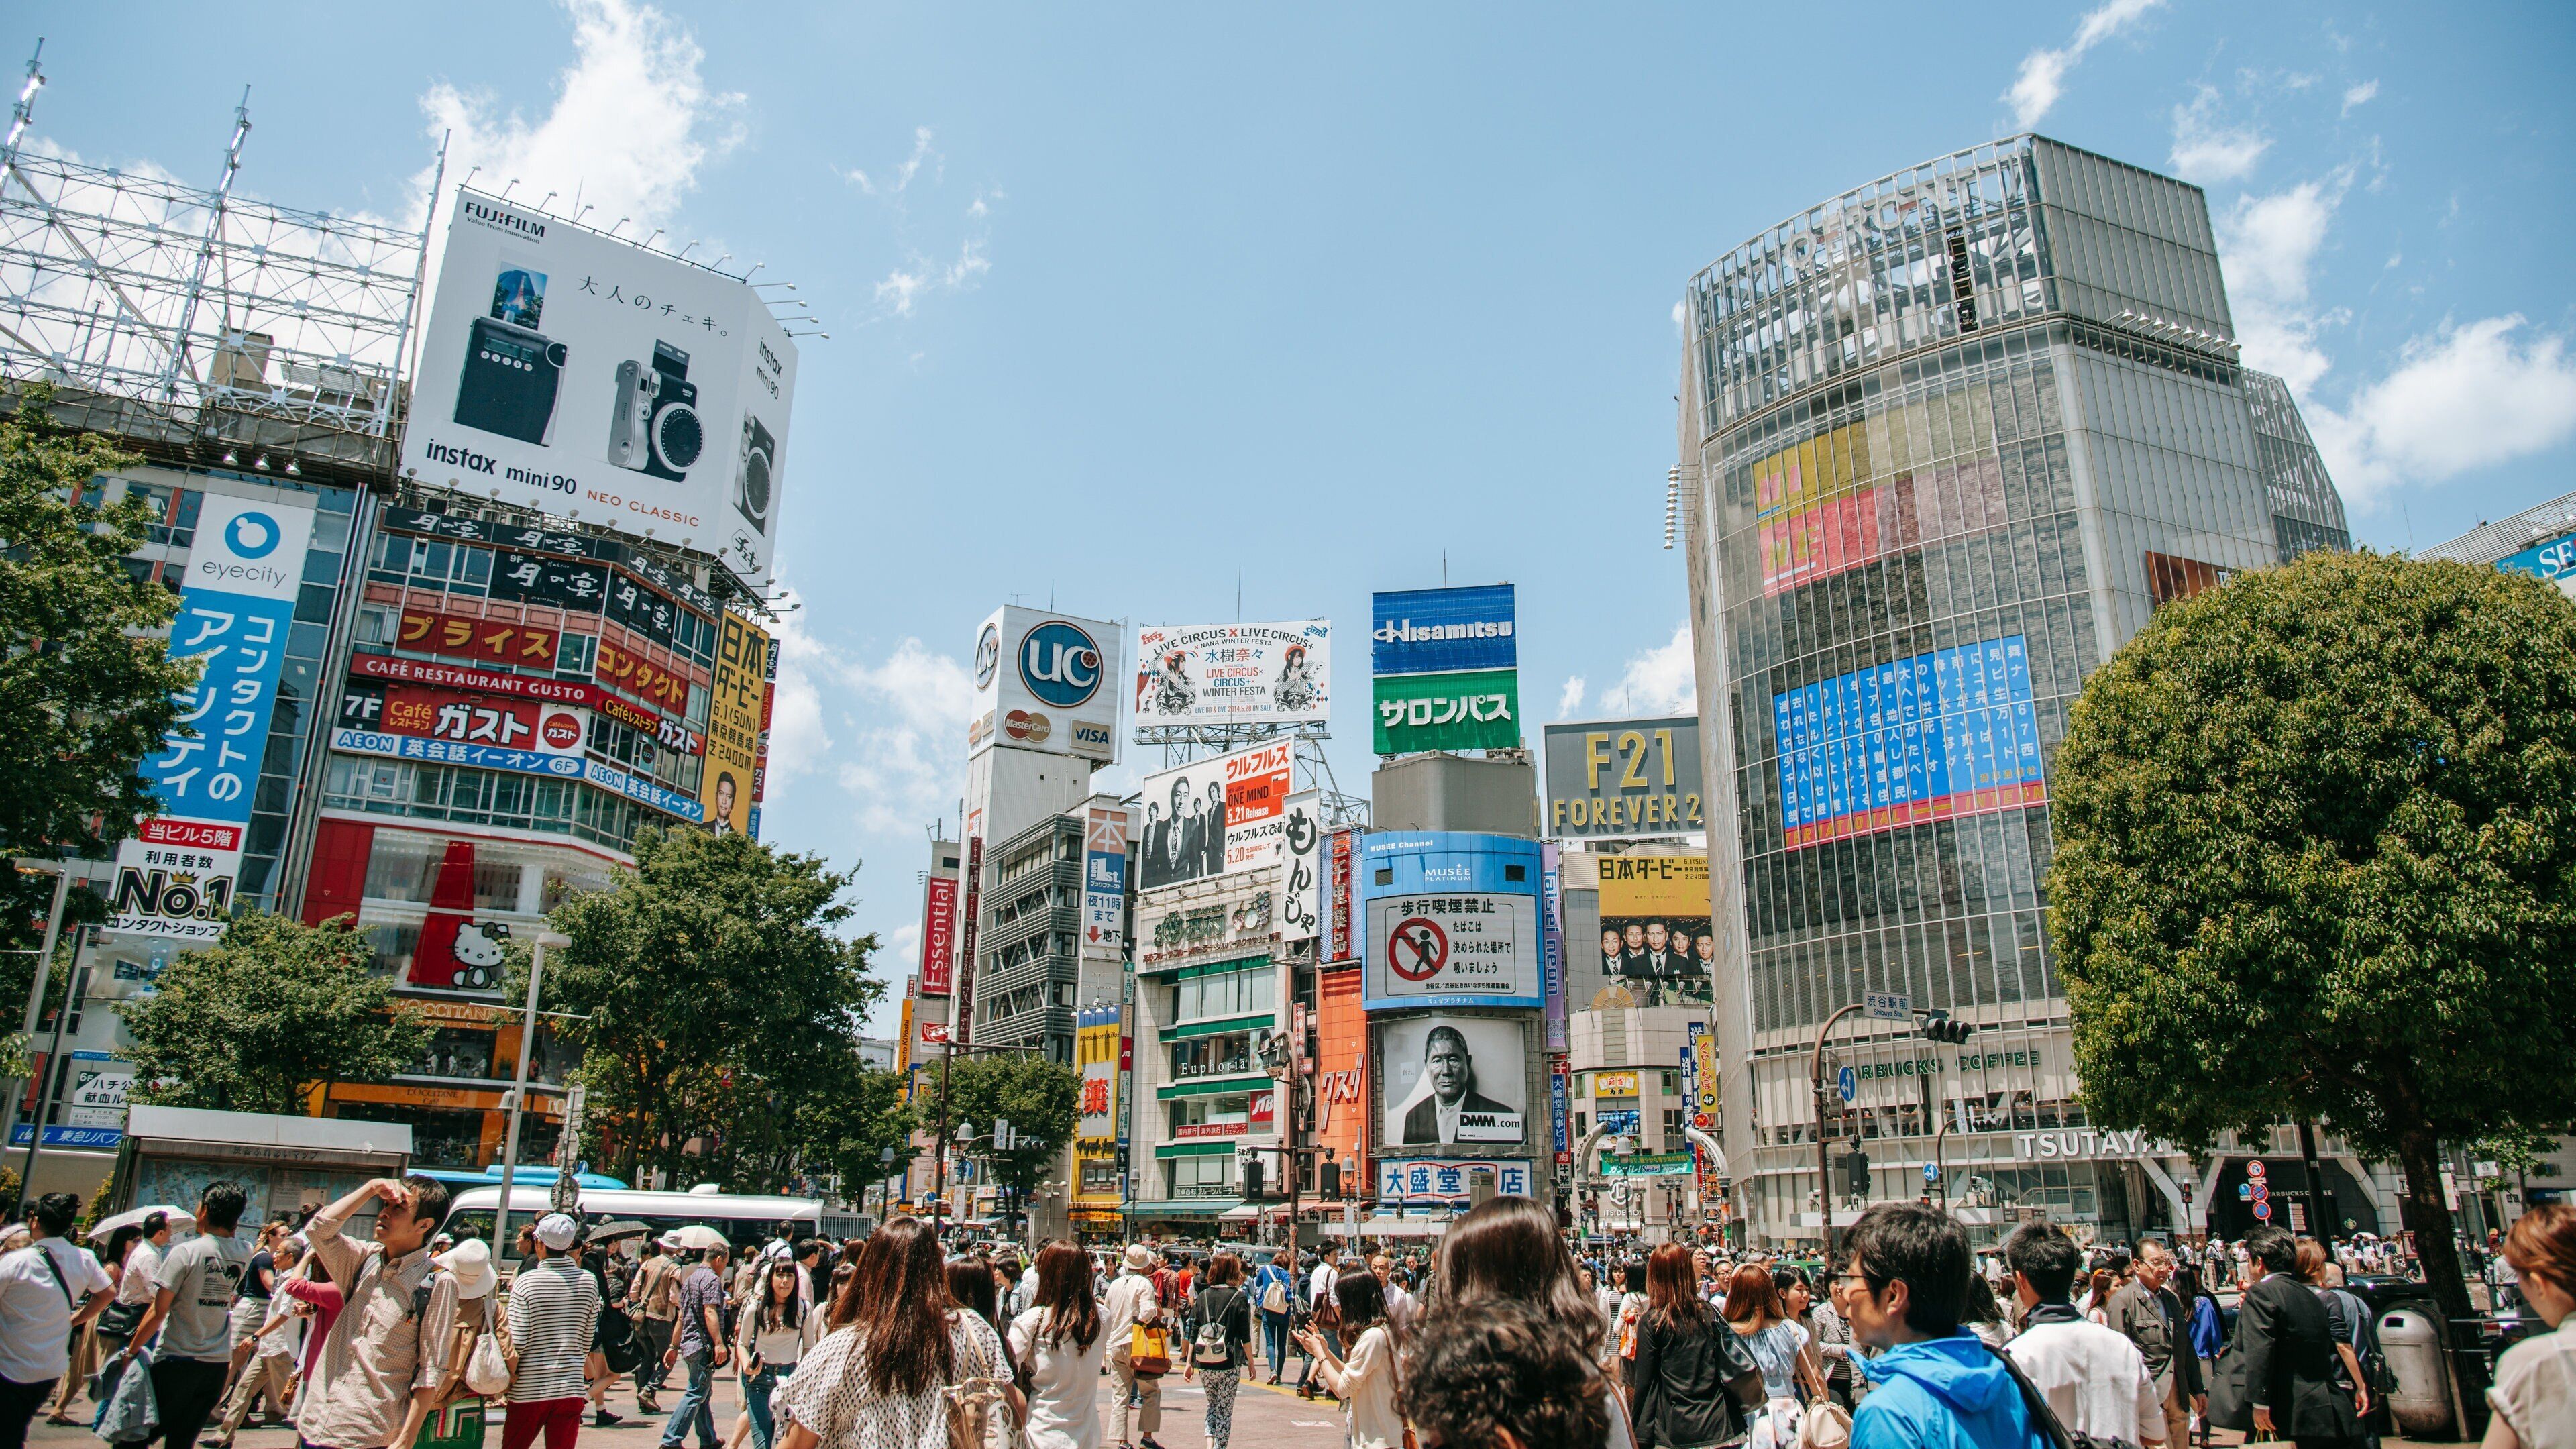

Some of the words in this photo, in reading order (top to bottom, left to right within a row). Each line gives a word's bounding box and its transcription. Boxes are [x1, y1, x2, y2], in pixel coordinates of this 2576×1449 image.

[465, 201, 545, 237] FUJIFILM
[467, 216, 486, 227] Value
[488, 223, 504, 232] from
[578, 276, 727, 337] 大人のチェキ。
[760, 337, 783, 380] instax
[425, 439, 497, 476] instax
[586, 488, 622, 507] NEO
[629, 499, 700, 528] CLASSIC
[409, 513, 480, 539] 月の宴
[514, 530, 583, 555] 月の宴
[509, 554, 524, 564] 9F
[203, 560, 287, 588] eyecity
[506, 562, 599, 598] 月の宴
[618, 576, 628, 585] 9F
[629, 555, 669, 588] 月の宴
[677, 582, 715, 612] 月の宴
[615, 586, 669, 631] 月の宴
[402, 614, 553, 660] プライス
[1153, 639, 1179, 656] LIVE
[1181, 628, 1226, 645] CIRCUS
[1241, 627, 1269, 638] LIVE
[1373, 619, 1513, 644] Hisamitsu
[720, 616, 765, 678] 日本
[1200, 640, 1220, 649] NANA
[1251, 638, 1273, 647] FESTA
[1205, 647, 1265, 664] 水樹奈々
[366, 660, 409, 677] CAFÉ
[413, 666, 524, 692] RESTAURANT
[529, 682, 585, 700] GUSTO
[597, 644, 684, 704] コンタクト
[1206, 668, 1226, 679] LIVE
[716, 663, 759, 710] ダービー
[1202, 687, 1237, 698] WINTER
[1239, 686, 1267, 696] FESTA
[207, 614, 276, 803] コンタクトの
[344, 695, 382, 718] 7F
[390, 700, 433, 720] Café
[1195, 706, 1205, 714] LIVE
[1205, 706, 1212, 714] BD
[1218, 705, 1228, 713] DVD
[1228, 704, 1252, 714] 2014.5.28
[1252, 704, 1260, 712] ON
[1260, 704, 1273, 712] SALE
[1379, 693, 1511, 727] サロンパス
[389, 717, 431, 731] レストラン
[433, 702, 531, 745] ガスト
[546, 727, 578, 740] ガスト
[1005, 718, 1051, 734] MasterCard
[337, 731, 394, 752] AEON
[657, 719, 698, 754] ガスト
[711, 719, 753, 753] 東京競馬場
[1075, 727, 1110, 745] VISA
[405, 738, 544, 769] 英会話イーオン
[708, 739, 717, 757] 芝
[554, 759, 574, 775] 6F
[1226, 741, 1291, 780] ウルフルズ
[1586, 729, 1675, 790] F21
[590, 763, 623, 789] AEON
[752, 769, 764, 796] ガスト
[627, 777, 702, 819] 英会話イーオン
[1228, 792, 1245, 808] ONE
[1246, 785, 1269, 803] MIND
[1227, 805, 1245, 824] 5.21
[1246, 806, 1269, 819] Release
[1553, 794, 1679, 828] FOREVER
[1685, 793, 1702, 822] 2
[147, 822, 233, 847] 当ビル5階
[1228, 824, 1269, 845] ウルフルズ
[1227, 846, 1245, 865] 5.20
[1370, 843, 1396, 853] MUSEE
[1399, 839, 1434, 849] Channel
[144, 850, 214, 870] 利用者数
[1285, 806, 1317, 934] もんじゃ
[1599, 858, 1682, 880] 日本ダービー
[114, 865, 234, 922] No.1
[1090, 880, 1122, 889] ブックファースト
[1087, 894, 1122, 910] 夜11時
[1401, 898, 1495, 916] 歩行喫煙禁止
[1544, 865, 1560, 933] Taisei
[105, 917, 224, 937] コンタクトショップ
[1093, 910, 1115, 923] まで
[1452, 920, 1482, 933] たばこは
[924, 881, 949, 990] Essential
[1102, 928, 1121, 943] 地下
[1452, 941, 1511, 955] 決められた場所で
[1453, 961, 1498, 975] 吸いましょう
[1545, 938, 1558, 996] neon
[1866, 994, 1909, 1010] 渋谷駅前
[1874, 1008, 1893, 1018] Shibuya
[1549, 1018, 1562, 1026] (03)
[1181, 1058, 1246, 1077] Euphoria
[1849, 1057, 1943, 1081] ARBUCKS
[1955, 1049, 2040, 1073] COFFEE
[79, 1072, 94, 1083] 6F
[93, 1079, 134, 1091] ハチ公
[1608, 1076, 1625, 1086] 麻雀
[407, 1087, 460, 1099] L'OCCITANE
[1084, 1077, 1108, 1114] 薬
[1703, 1095, 1715, 1104] 4F
[1252, 1094, 1274, 1116] JTB
[1553, 1079, 1565, 1147] 大盛堂商事ビル
[1178, 1128, 1197, 1136] 国内旅行
[1201, 1126, 1221, 1134] 海外旅行
[1459, 1114, 1520, 1128] DMM.com
[2017, 1128, 2164, 1159] TSUTAYA
[1386, 1167, 1524, 1195] 大盛堂店
[1559, 1163, 1570, 1185] 牛繁
